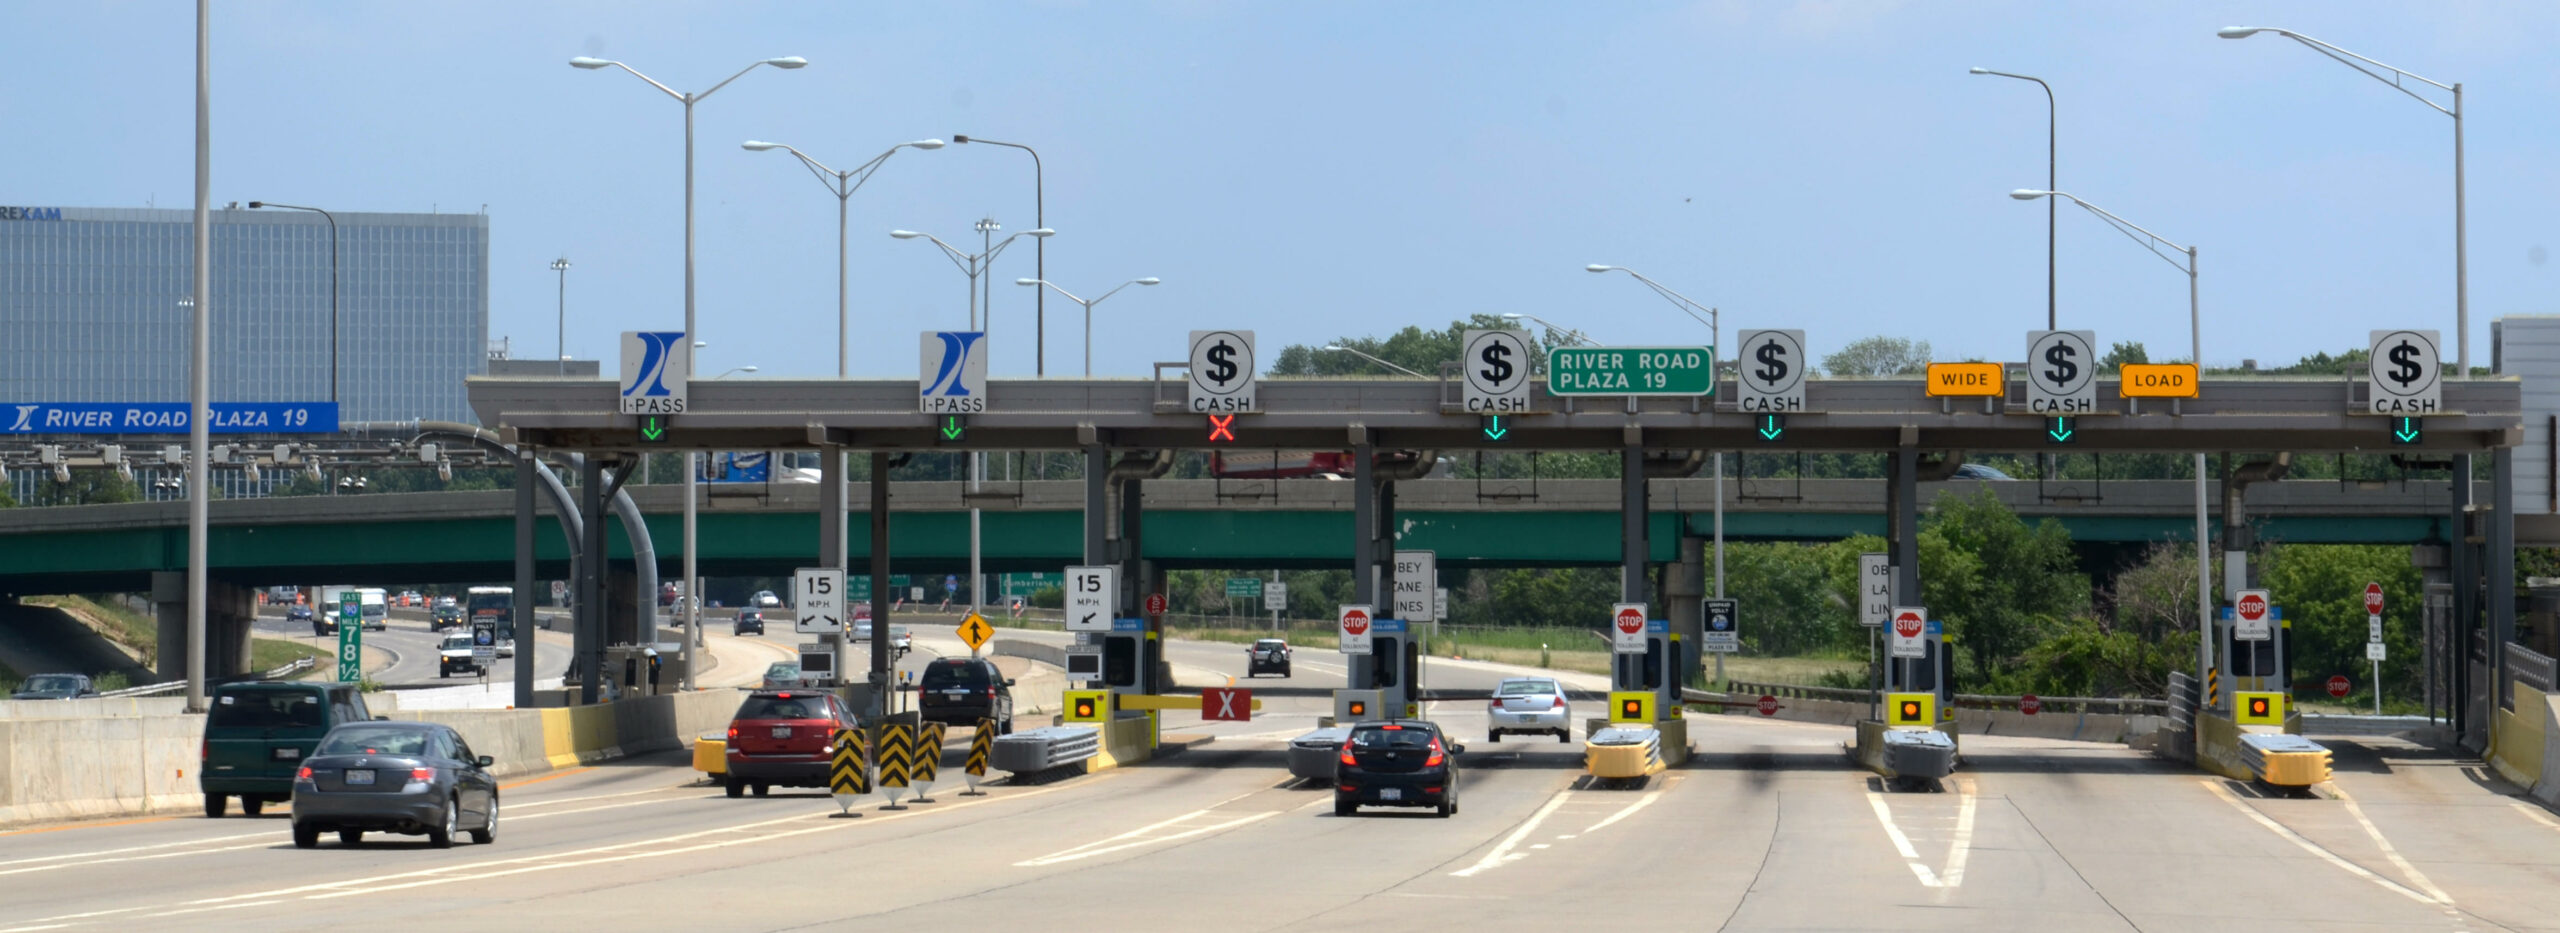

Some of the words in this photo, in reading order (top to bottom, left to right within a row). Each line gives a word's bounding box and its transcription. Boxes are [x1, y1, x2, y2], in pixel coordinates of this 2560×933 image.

[0, 206, 62, 220] REXAM
[1560, 353, 1624, 369] RIVER
[1639, 353, 1701, 369] ROAD
[1560, 372, 1630, 389] PLAZA
[1643, 372, 1667, 389] 19
[1941, 373, 1988, 386] WIDE
[2135, 374, 2183, 387] LOAD
[623, 398, 684, 413] I-PASS
[922, 397, 983, 412] I-PASS
[1194, 397, 1250, 412] CASH
[1468, 397, 1525, 412] CASH
[1743, 396, 1800, 411] CASH
[2032, 398, 2091, 413] CASH
[2375, 398, 2436, 413] CASH
[45, 408, 113, 427] RIVER
[123, 408, 187, 427] ROAD
[282, 408, 309, 426] 19
[1393, 562, 1422, 573] BEY
[1871, 564, 1889, 576] OB
[808, 577, 832, 595] 15
[1077, 575, 1101, 592] 15
[1872, 584, 1889, 596] LA
[2366, 592, 2383, 605] STOP
[1395, 601, 1424, 612] INES
[1871, 604, 1890, 615] LIN
[2240, 602, 2265, 614] STOP
[342, 618, 359, 626] MILE
[1344, 617, 1367, 628] STOP
[1618, 616, 1642, 627] STOP
[1896, 620, 1920, 632] STOP
[345, 626, 357, 643] 7
[344, 644, 357, 660] 8
[340, 663, 360, 680] 1/2
[2328, 682, 2348, 691] STOP
[1758, 701, 1777, 710] STOP
[2020, 700, 2040, 710] STOP
